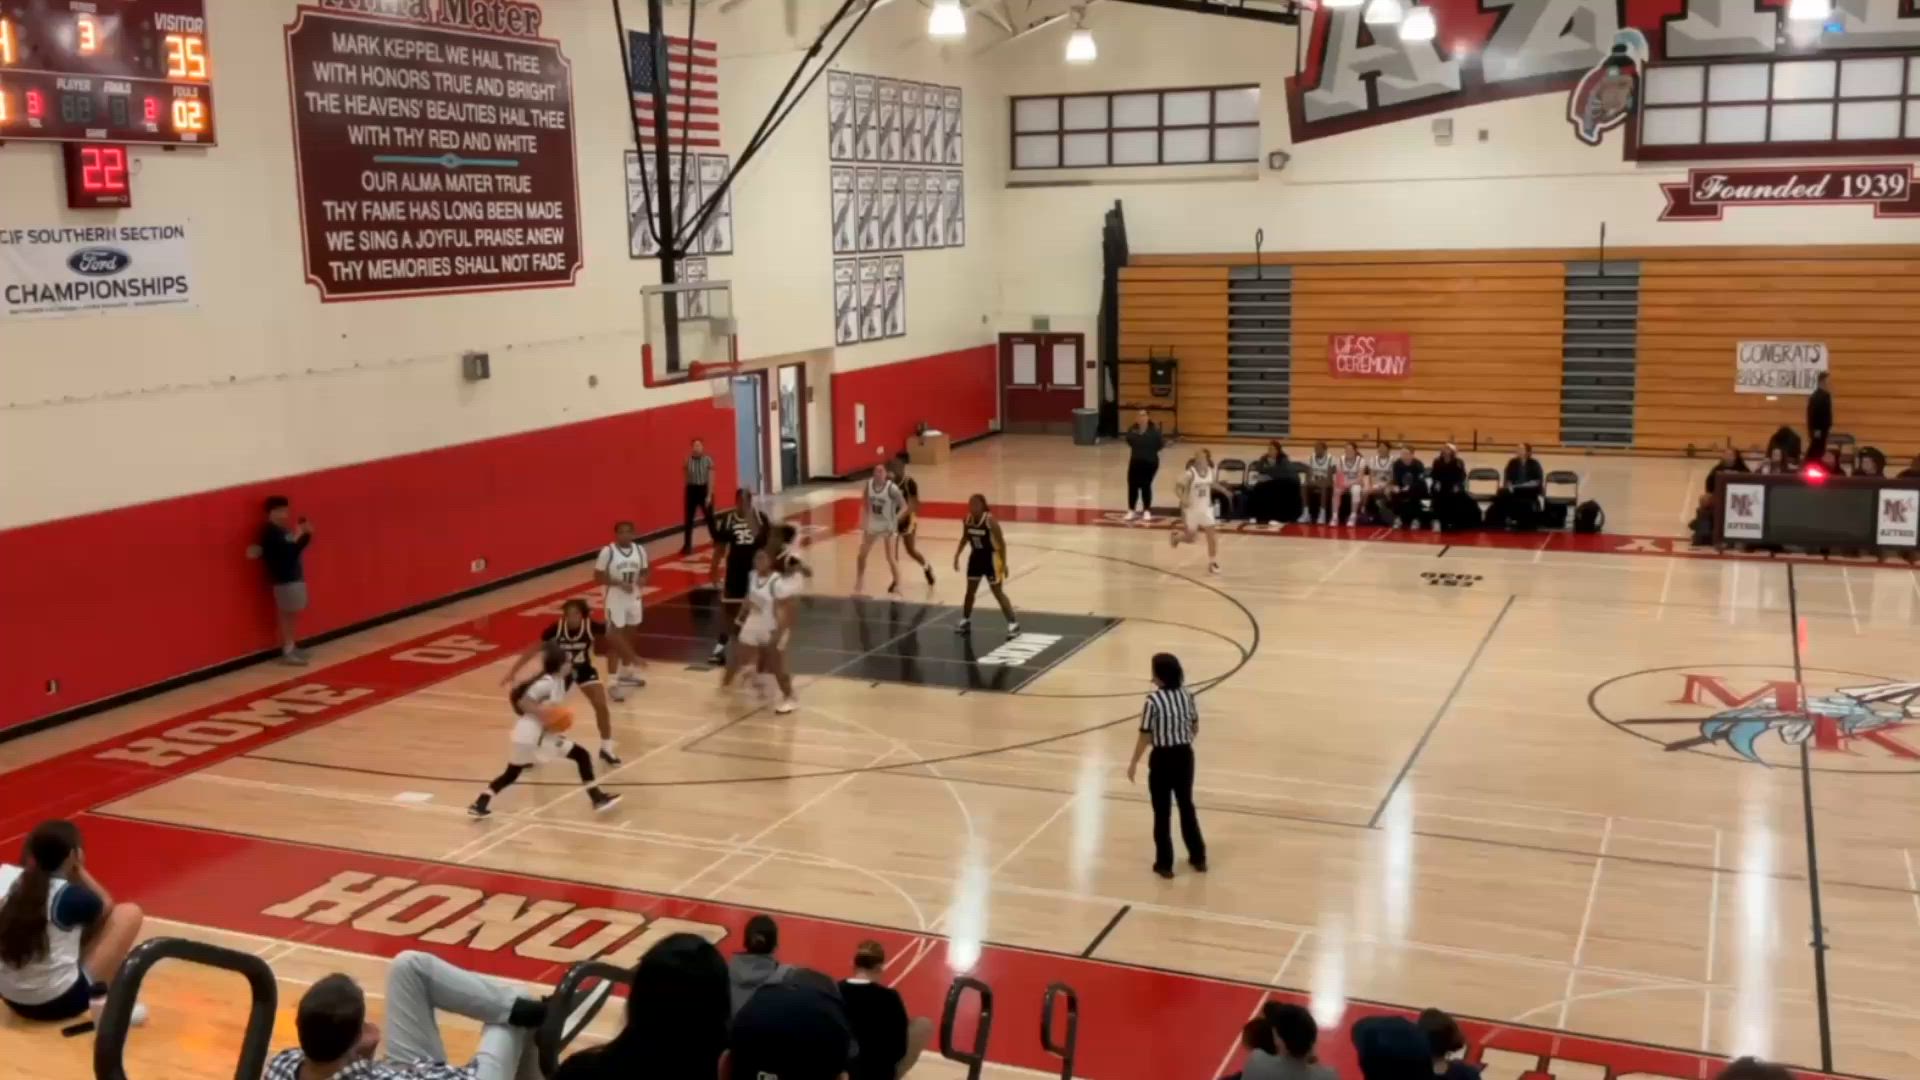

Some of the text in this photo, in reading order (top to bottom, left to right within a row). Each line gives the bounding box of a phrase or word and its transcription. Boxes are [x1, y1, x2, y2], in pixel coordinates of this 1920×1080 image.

[78, 20, 95, 49] 3
[154, 12, 203, 32] VISITOR
[165, 35, 206, 77] 35
[332, 32, 540, 74] MARK KEPPEL WE HAIL THEE
[56, 78, 91, 91] PLAYER
[313, 62, 555, 101] WITH HONORS TRUE AND BRIGHT
[172, 99, 202, 129] 02
[305, 92, 565, 129] THE HEAVENS' BEAUTIES HAIL THEE
[348, 125, 537, 153] WITH THY RED AND WHITE
[82, 148, 124, 189] 22
[361, 170, 531, 193] OUR ALMA MATER TRUE
[1696, 173, 1905, 200] Founded 1939
[323, 200, 563, 221] THY FAME HAS LONG BEEN MADE
[0, 225, 184, 245] CIF SOUTHERN SECTION
[326, 227, 564, 251] WE SING A JOYFUL PRAISE ANEW
[79, 251, 118, 271] Ford
[329, 252, 566, 281] THY MEMORIES SHALL NOT FADE
[5, 275, 188, 304] CHAMPIONSHIPS
[1740, 344, 1820, 363] CONGRATS
[94, 634, 499, 768] HOME OF
